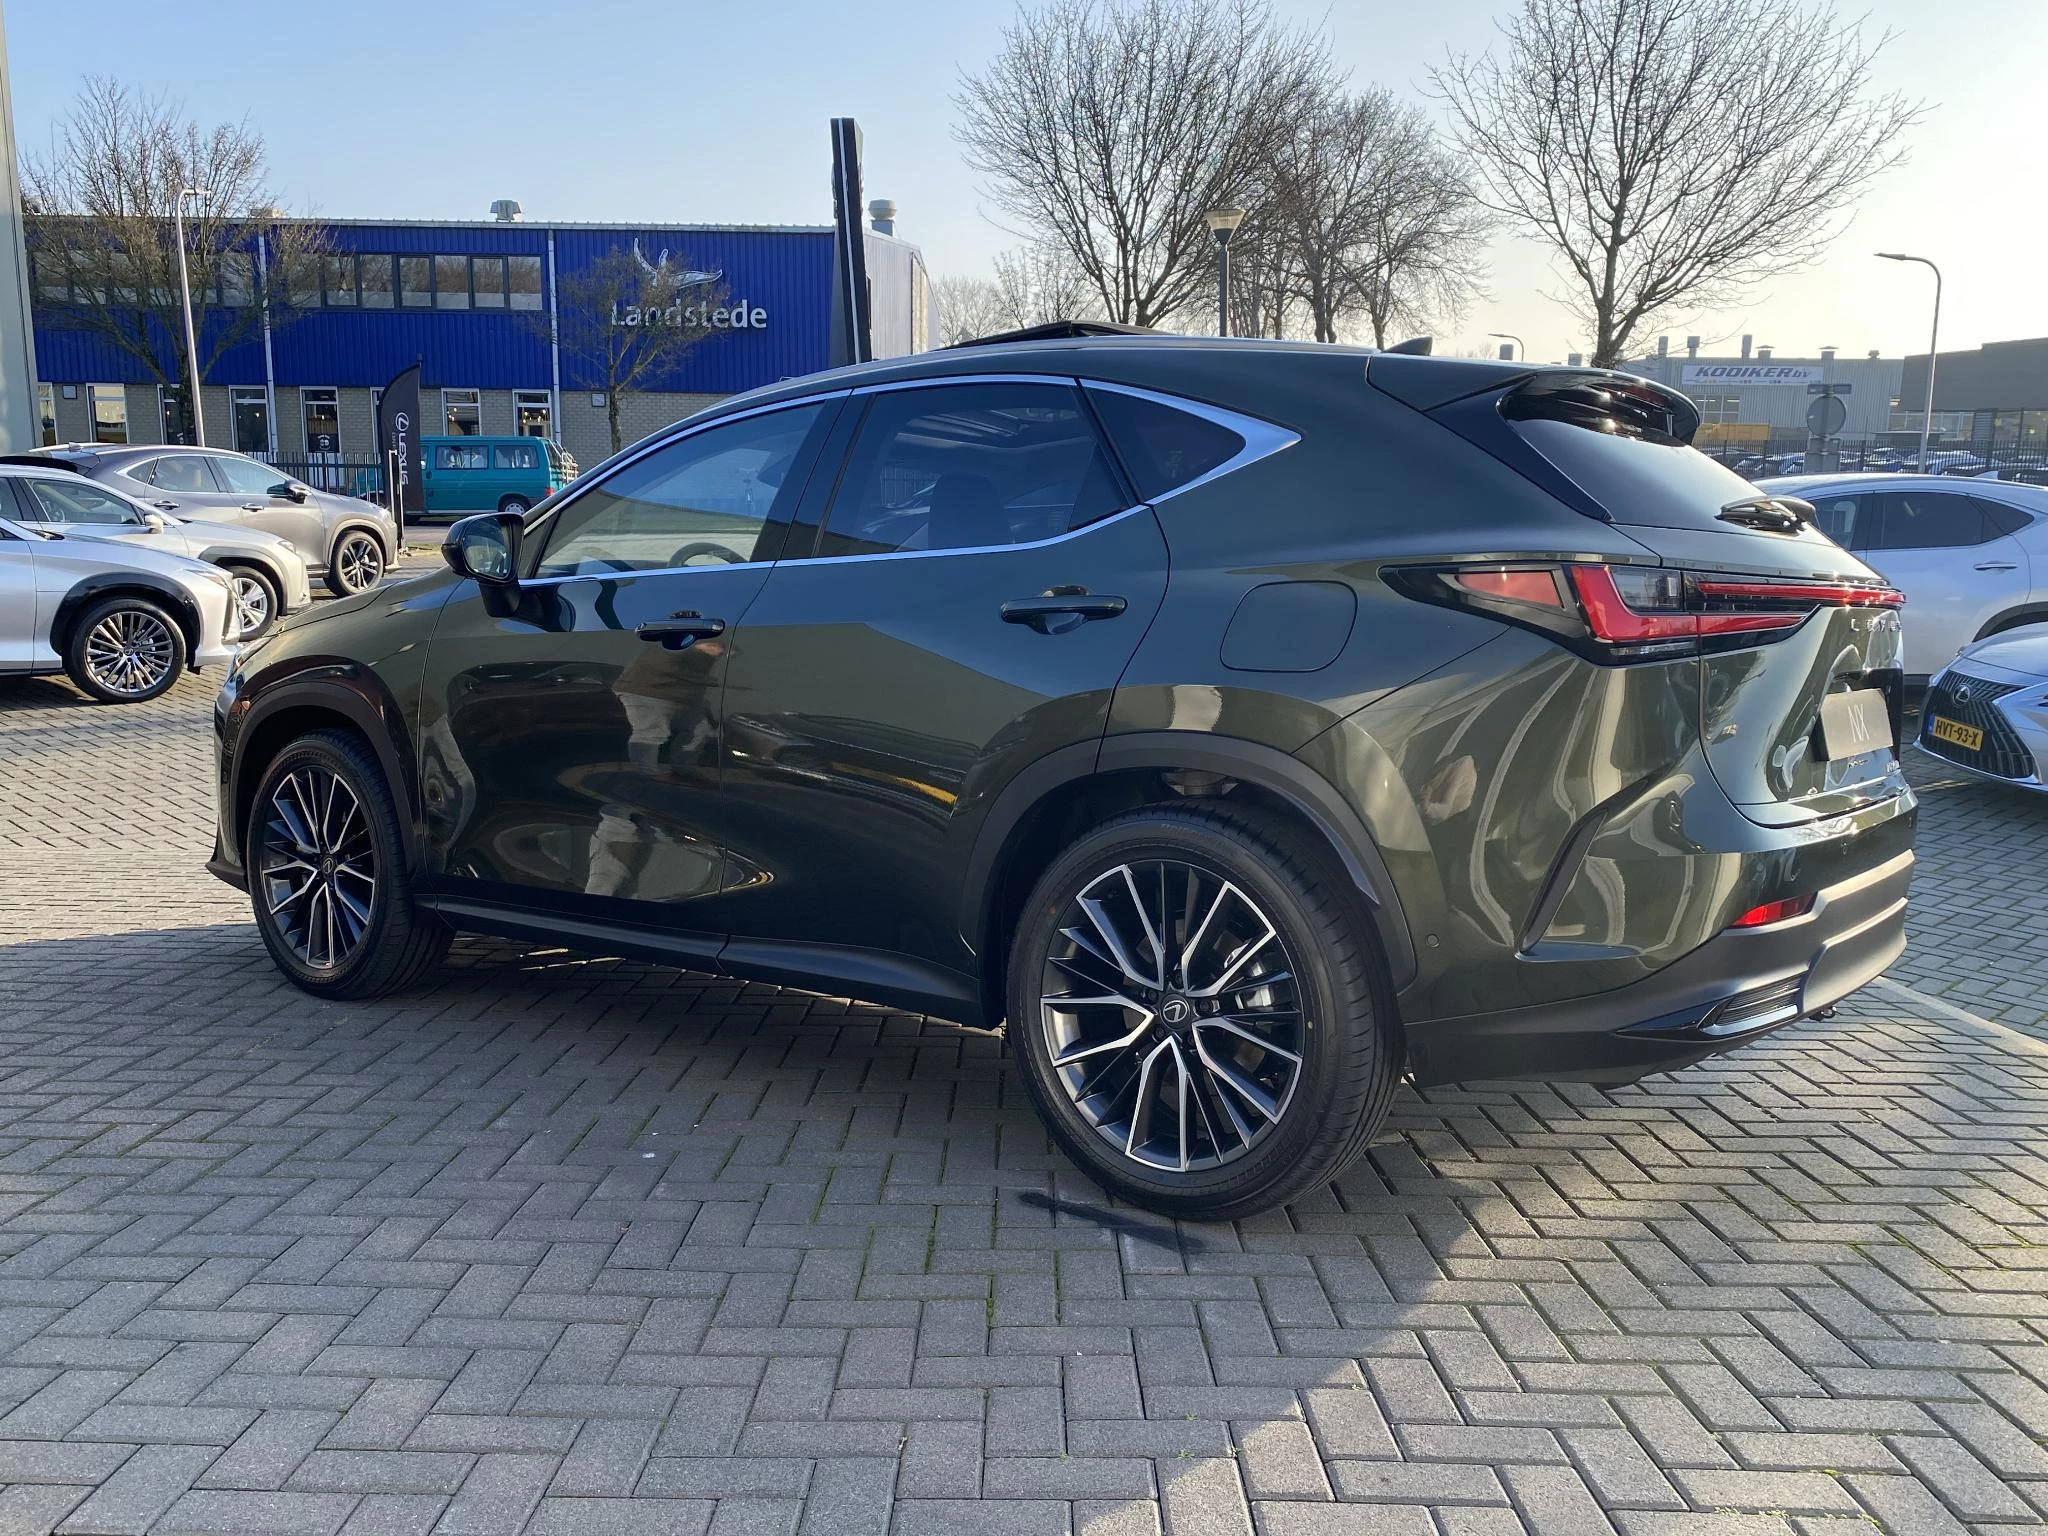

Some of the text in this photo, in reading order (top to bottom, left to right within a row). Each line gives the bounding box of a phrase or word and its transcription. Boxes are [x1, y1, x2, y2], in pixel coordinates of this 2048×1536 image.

[611, 299, 767, 328] Landstede
[1695, 367, 1793, 378] KOOIKER
[398, 433, 408, 486] LEXUS
[1847, 703, 1870, 743] NX
[1935, 719, 1979, 746] HVT-93-X
